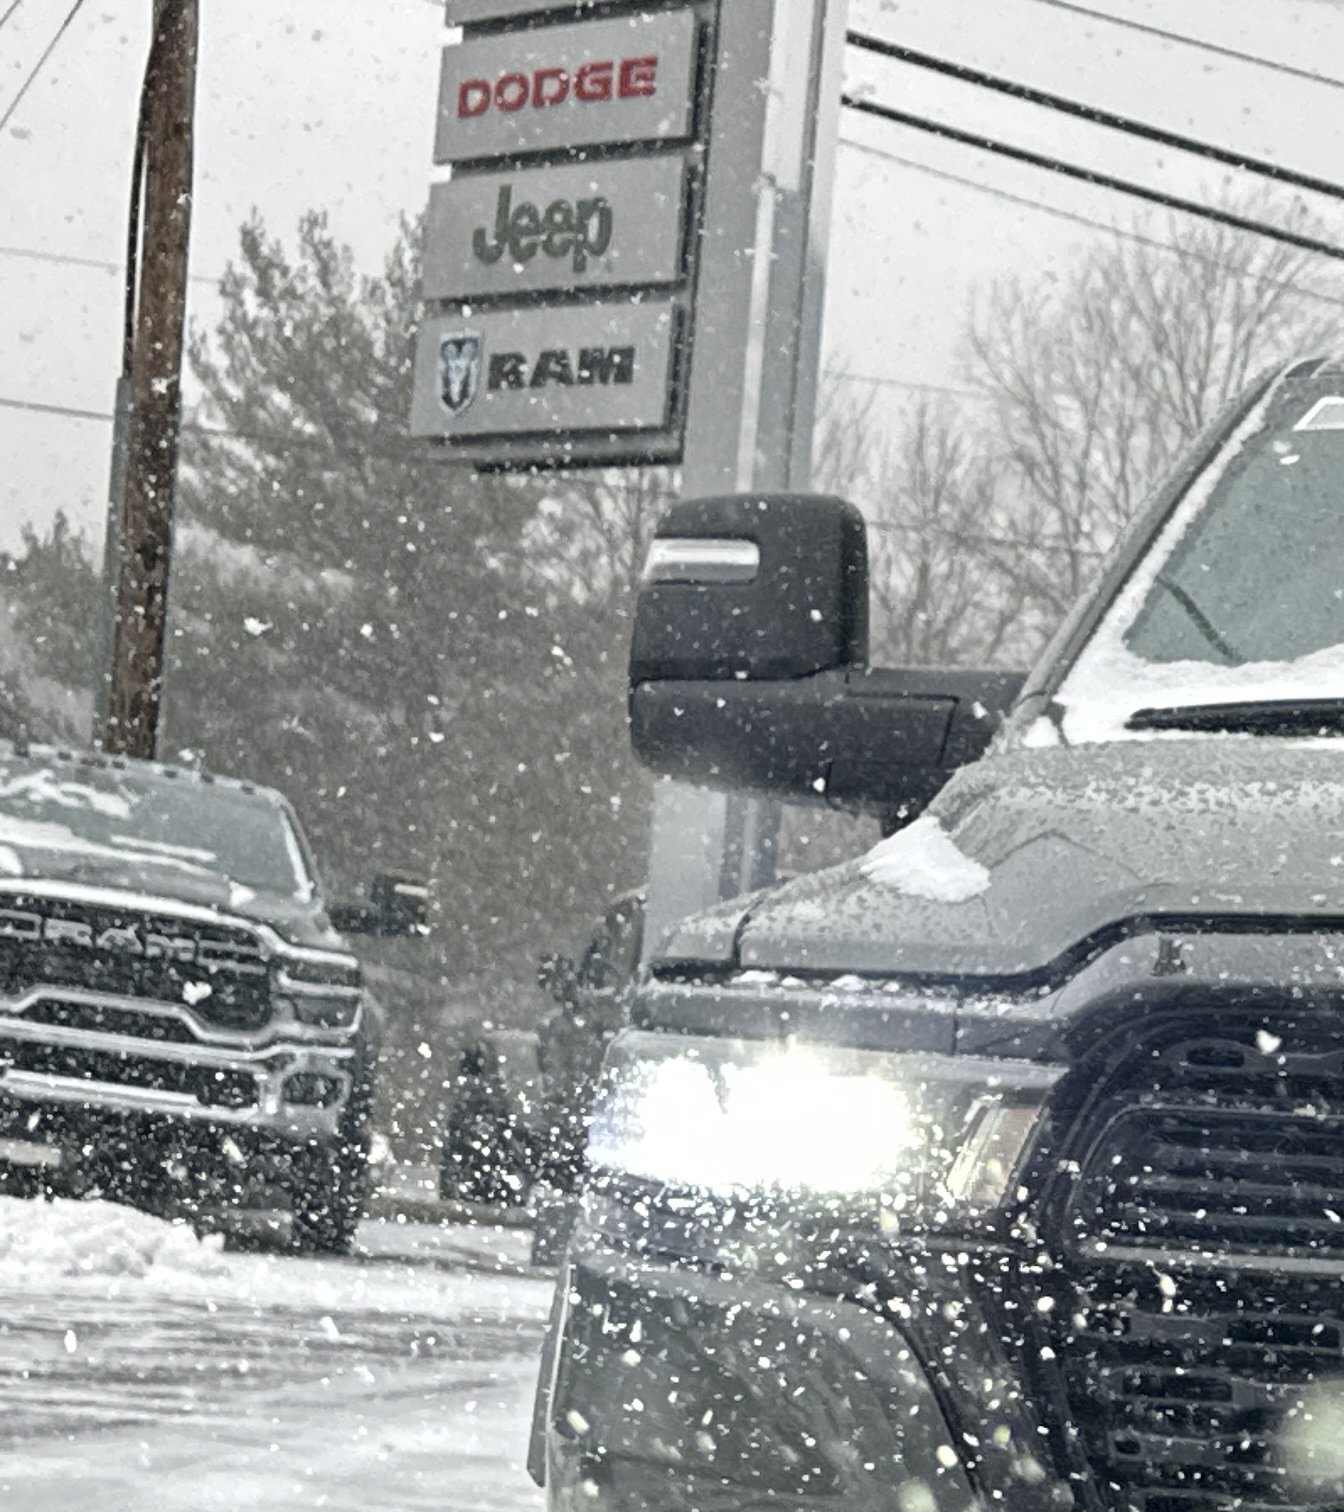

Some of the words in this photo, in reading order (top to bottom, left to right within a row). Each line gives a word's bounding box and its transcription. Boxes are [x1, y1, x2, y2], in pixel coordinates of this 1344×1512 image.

[457, 57, 657, 118] DODGE
[473, 184, 612, 272] Jeep
[488, 347, 635, 390] RAM
[44, 918, 196, 962] RAM
